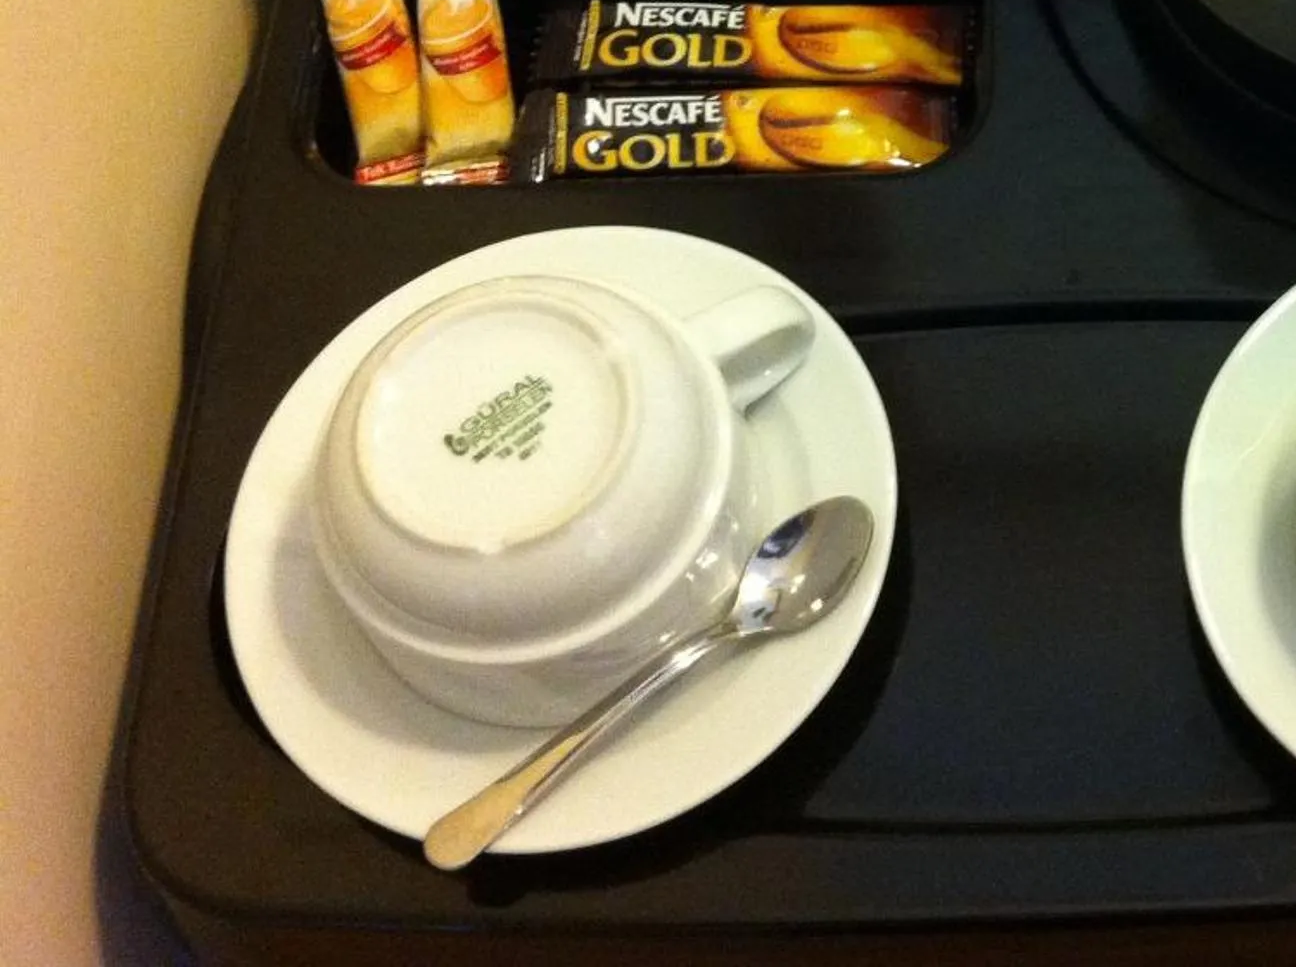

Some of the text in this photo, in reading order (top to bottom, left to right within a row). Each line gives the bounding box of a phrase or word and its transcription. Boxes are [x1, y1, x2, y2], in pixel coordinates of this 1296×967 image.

[614, 1, 746, 29] NESCAFÉ
[598, 29, 752, 68] GOLD
[584, 94, 724, 128] NESCAFÉ
[571, 130, 736, 172] GOLD
